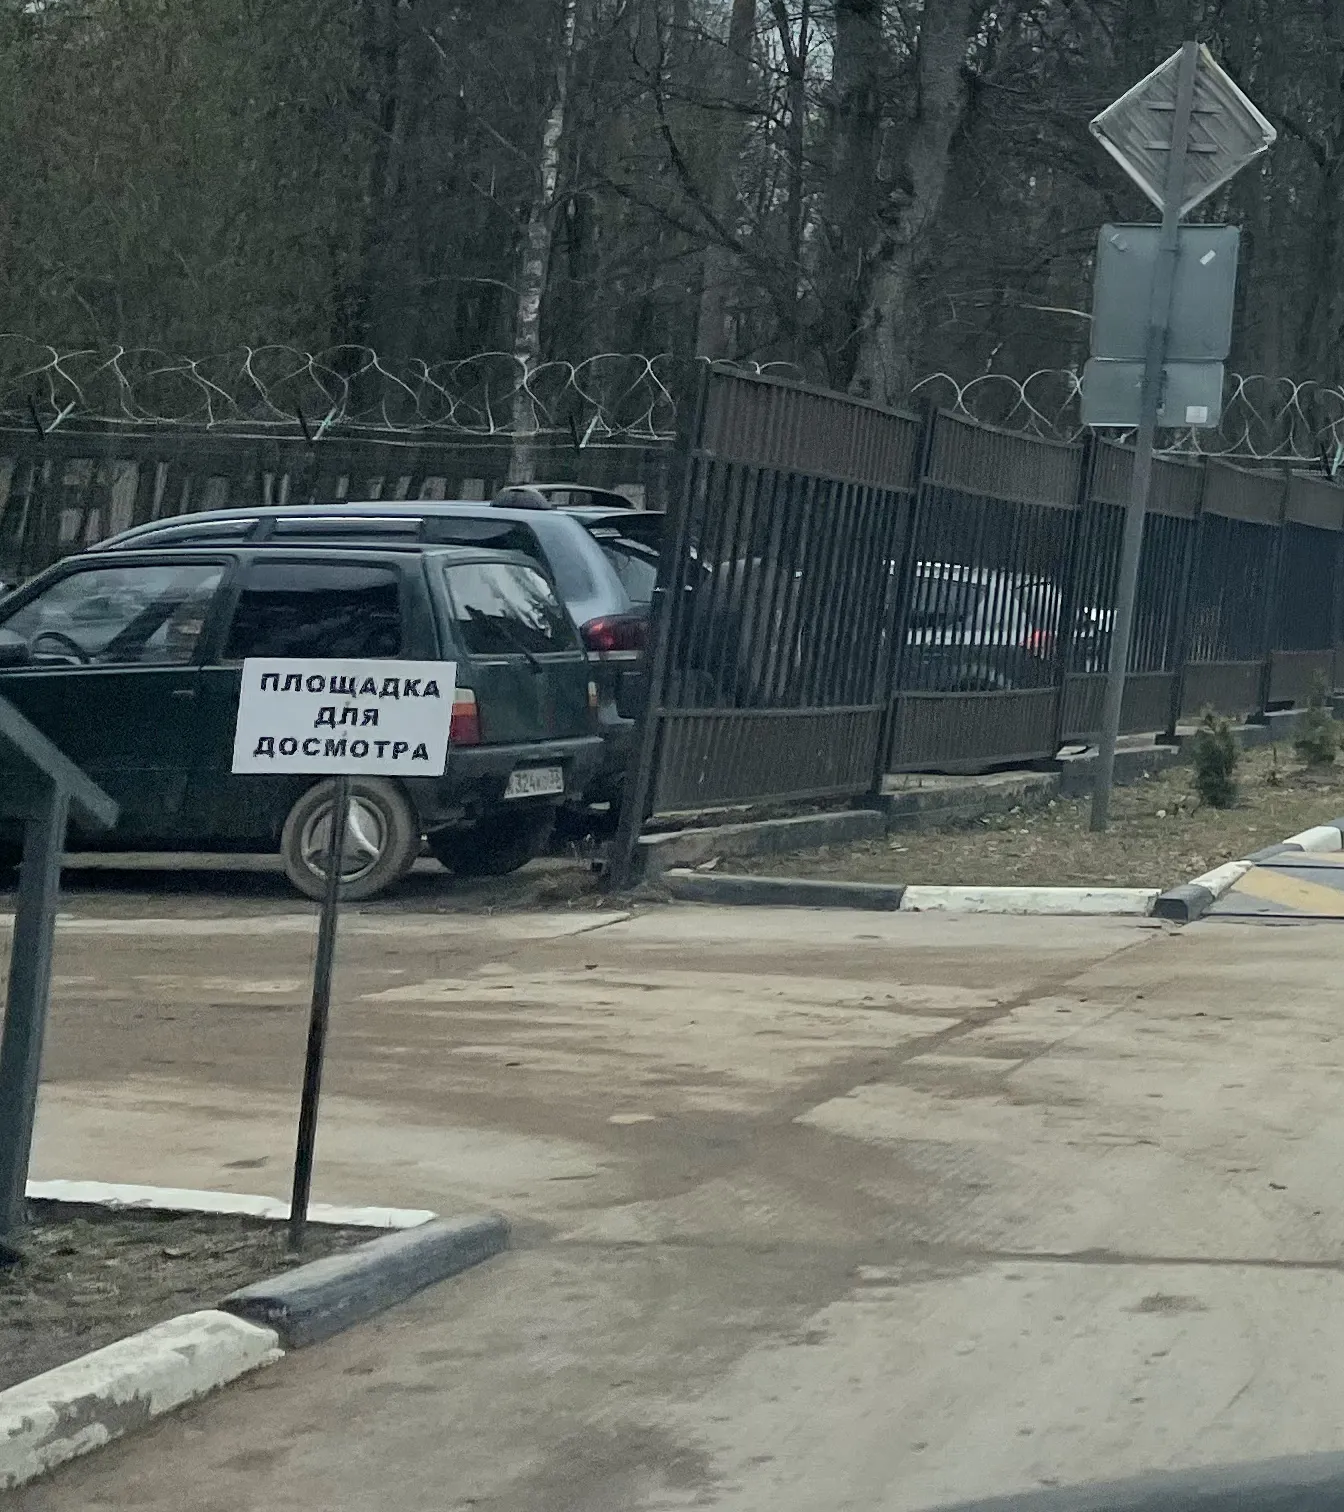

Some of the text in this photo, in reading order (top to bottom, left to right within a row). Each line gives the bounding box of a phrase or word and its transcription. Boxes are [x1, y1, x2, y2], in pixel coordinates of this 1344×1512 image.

[260, 672, 440, 699] ПЛОЩАДКА
[313, 706, 379, 729] ДЛЯ
[252, 736, 429, 761] ДОСМОТРА
